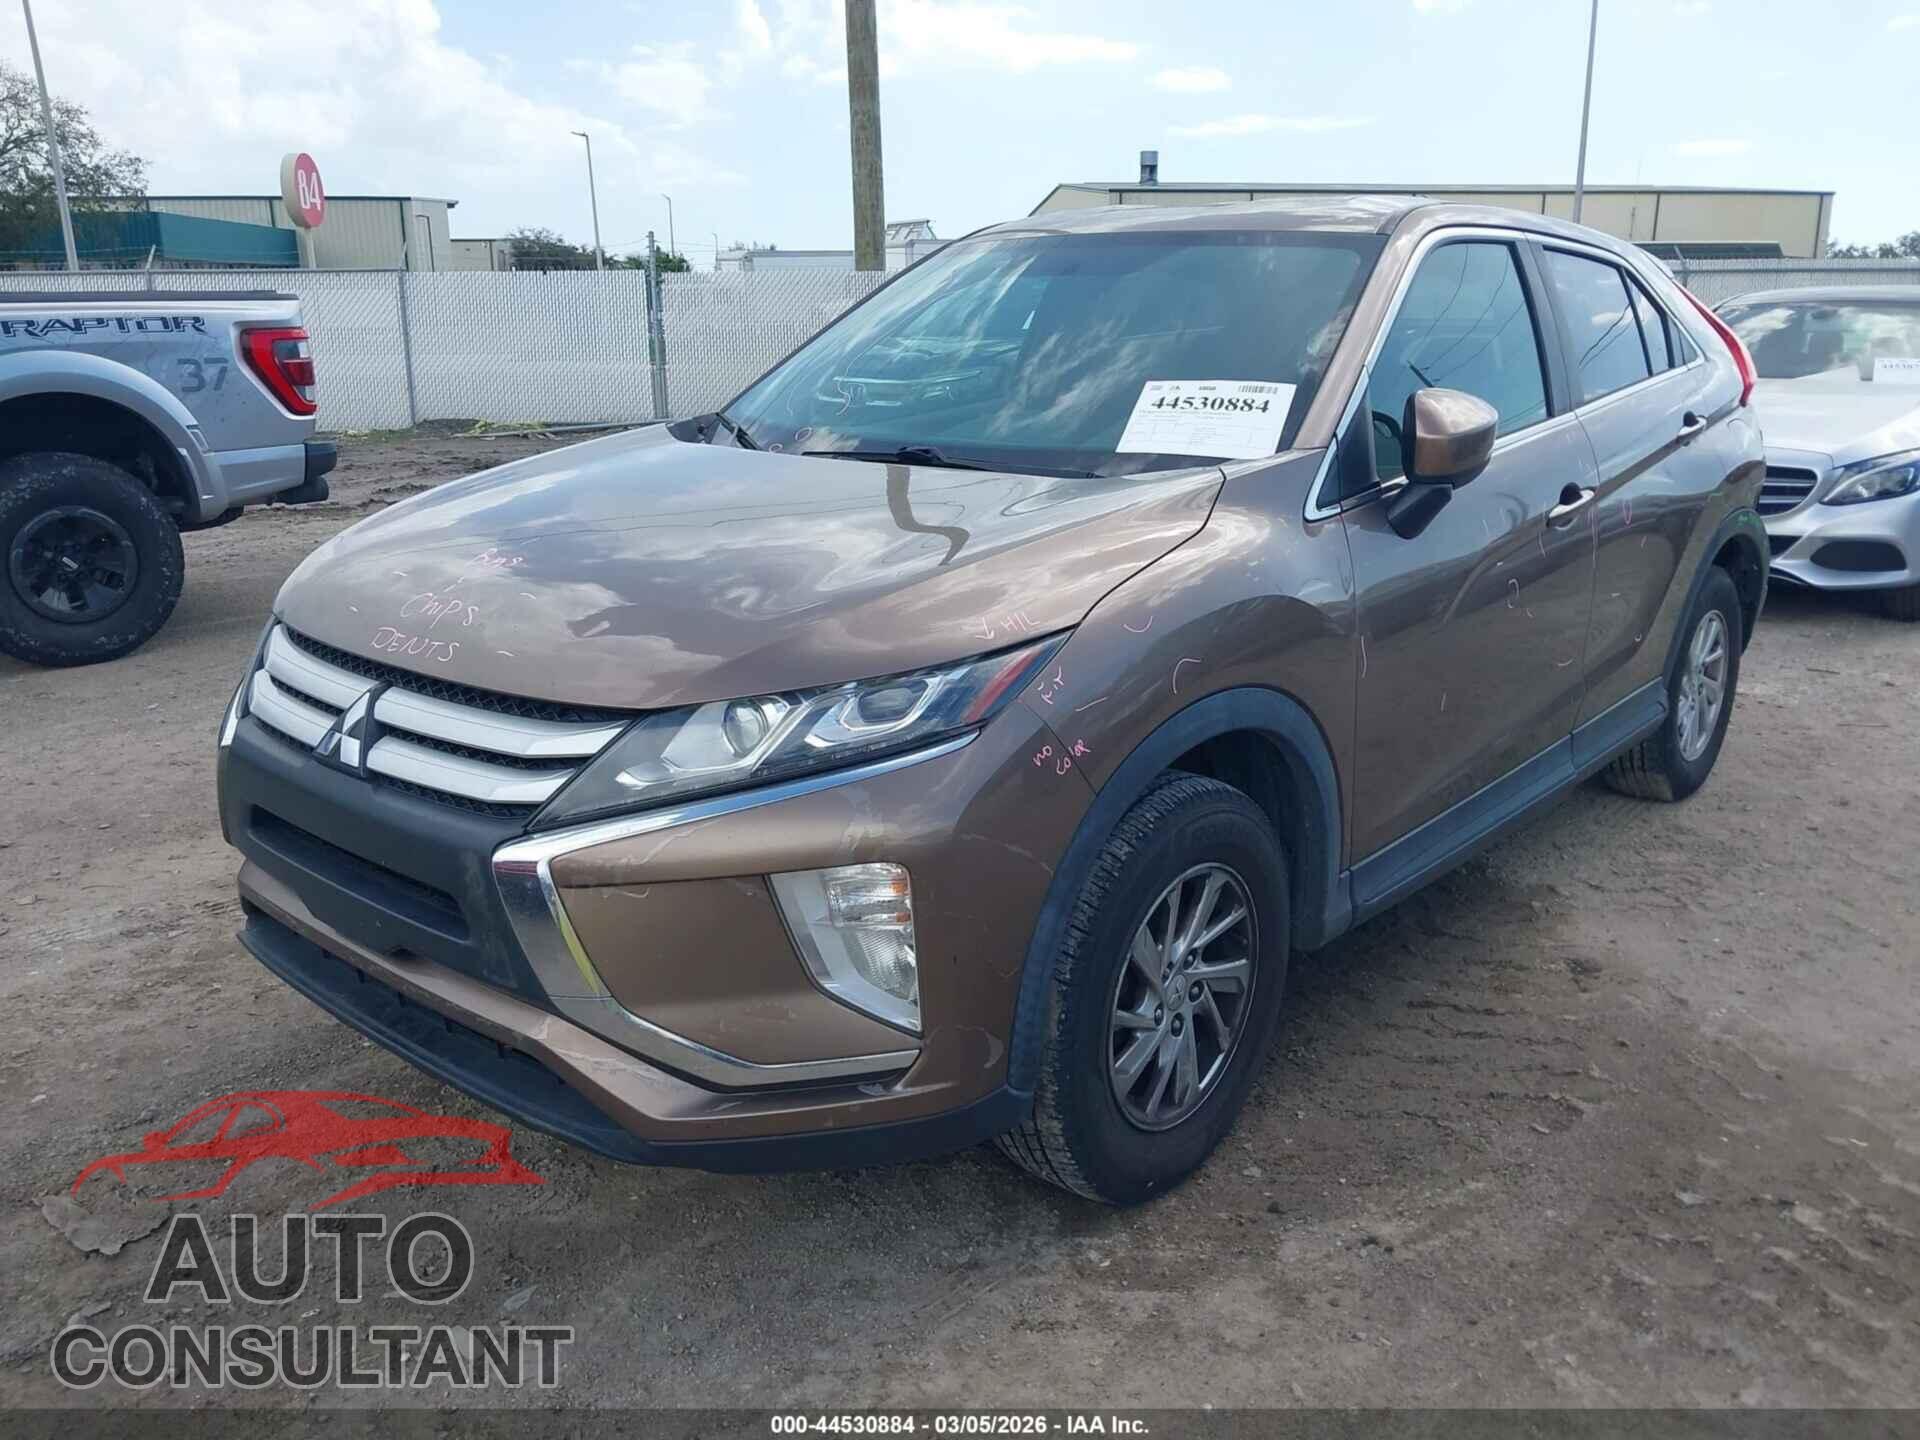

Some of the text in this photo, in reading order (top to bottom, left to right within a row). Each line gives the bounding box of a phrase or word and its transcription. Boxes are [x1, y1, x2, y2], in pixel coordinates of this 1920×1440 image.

[298, 169, 321, 211] 84
[1, 316, 207, 337] RAPTOR
[177, 357, 228, 392] 37
[1151, 395, 1271, 414] 44530884
[371, 626, 460, 662] DENTS
